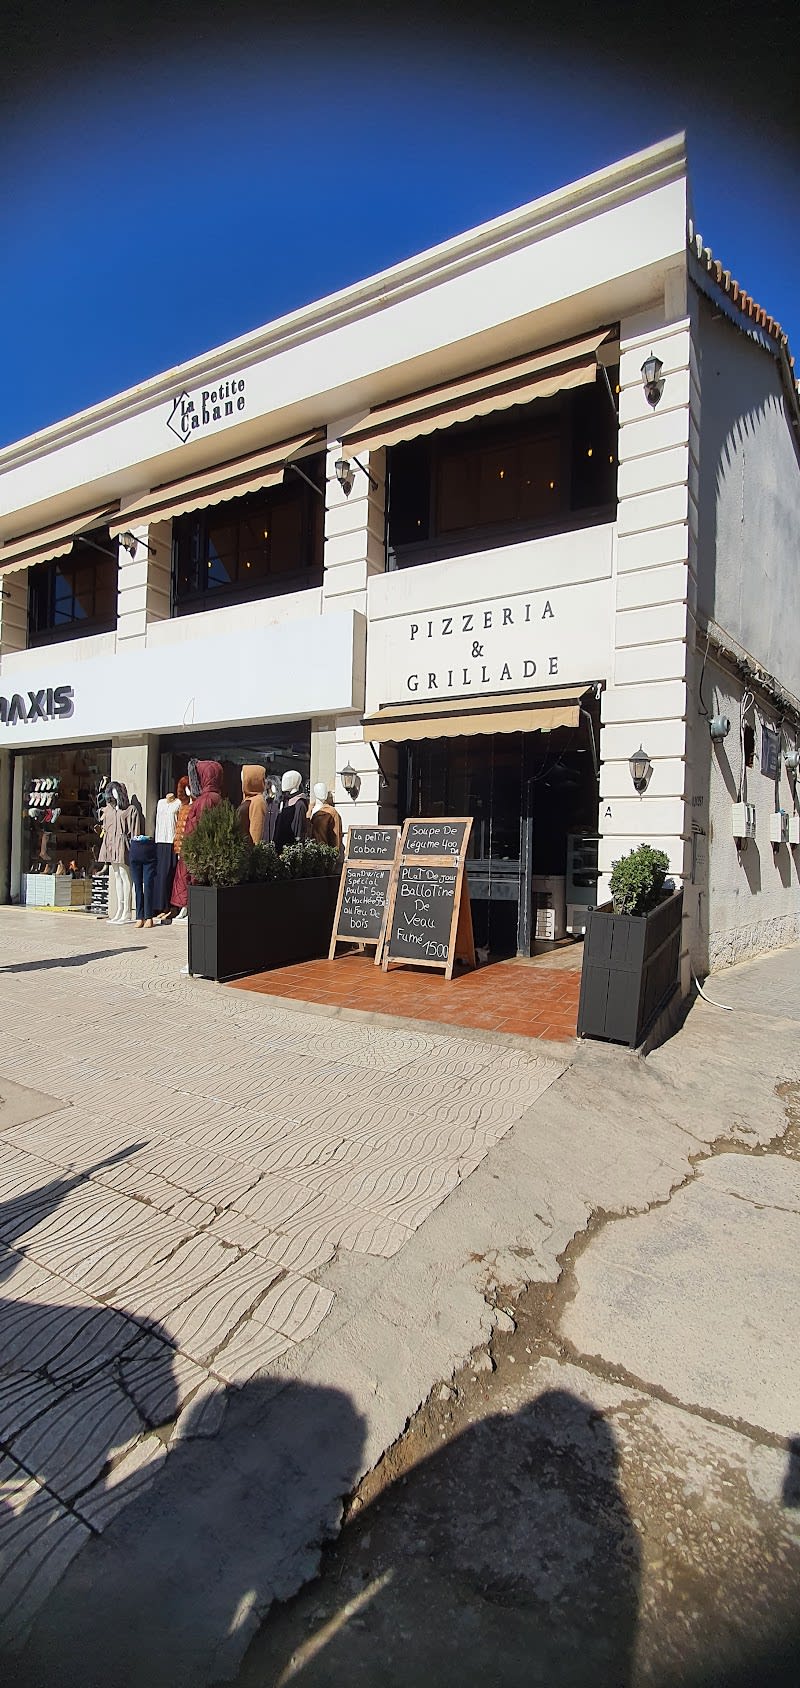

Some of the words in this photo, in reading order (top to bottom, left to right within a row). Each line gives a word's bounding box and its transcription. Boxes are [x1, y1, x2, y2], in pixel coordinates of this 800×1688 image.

[180, 400, 195, 416] La
[201, 379, 245, 407] Petite
[180, 396, 245, 433] Cabane
[410, 600, 555, 641] PIZZERIA
[471, 640, 484, 658] &
[407, 656, 559, 692] GRILLADE
[412, 825, 441, 838] Soupe
[443, 825, 458, 836] De
[353, 844, 388, 854] cabane
[441, 838, 458, 850] 400
[426, 869, 438, 880] De
[343, 907, 353, 915] au
[414, 899, 430, 911] De
[350, 917, 369, 929] bois
[403, 911, 436, 928] Veau
[396, 927, 424, 945] Fumé
[421, 940, 449, 958] 1500
